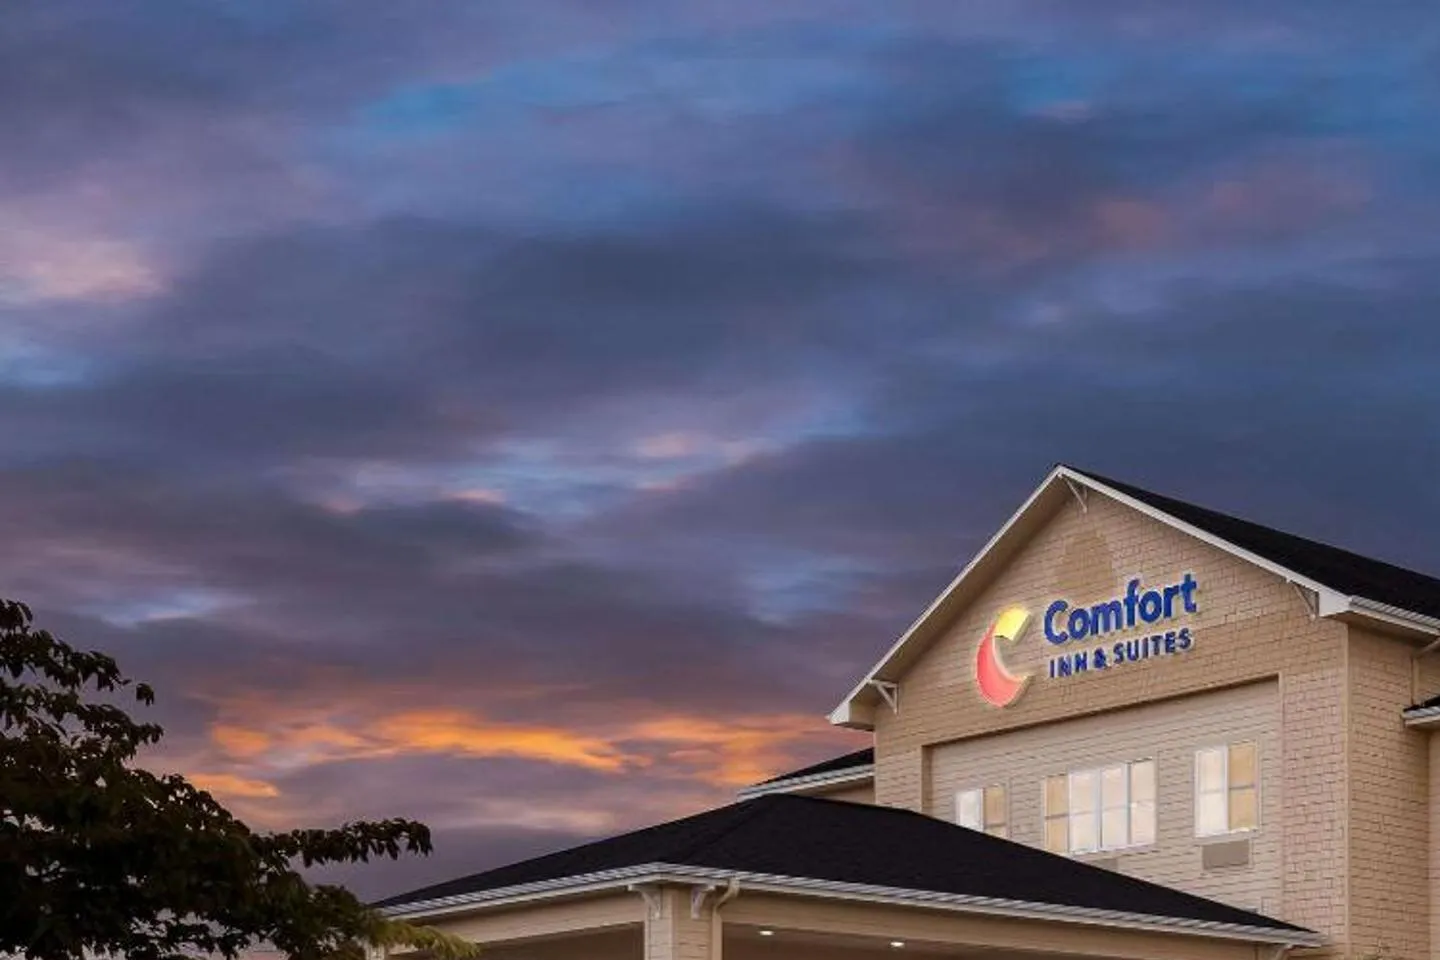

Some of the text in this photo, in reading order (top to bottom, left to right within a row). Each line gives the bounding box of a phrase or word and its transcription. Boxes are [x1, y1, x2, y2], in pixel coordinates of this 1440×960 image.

[1044, 573, 1197, 645] Comfort
[1049, 627, 1193, 679] INN & SUITES
